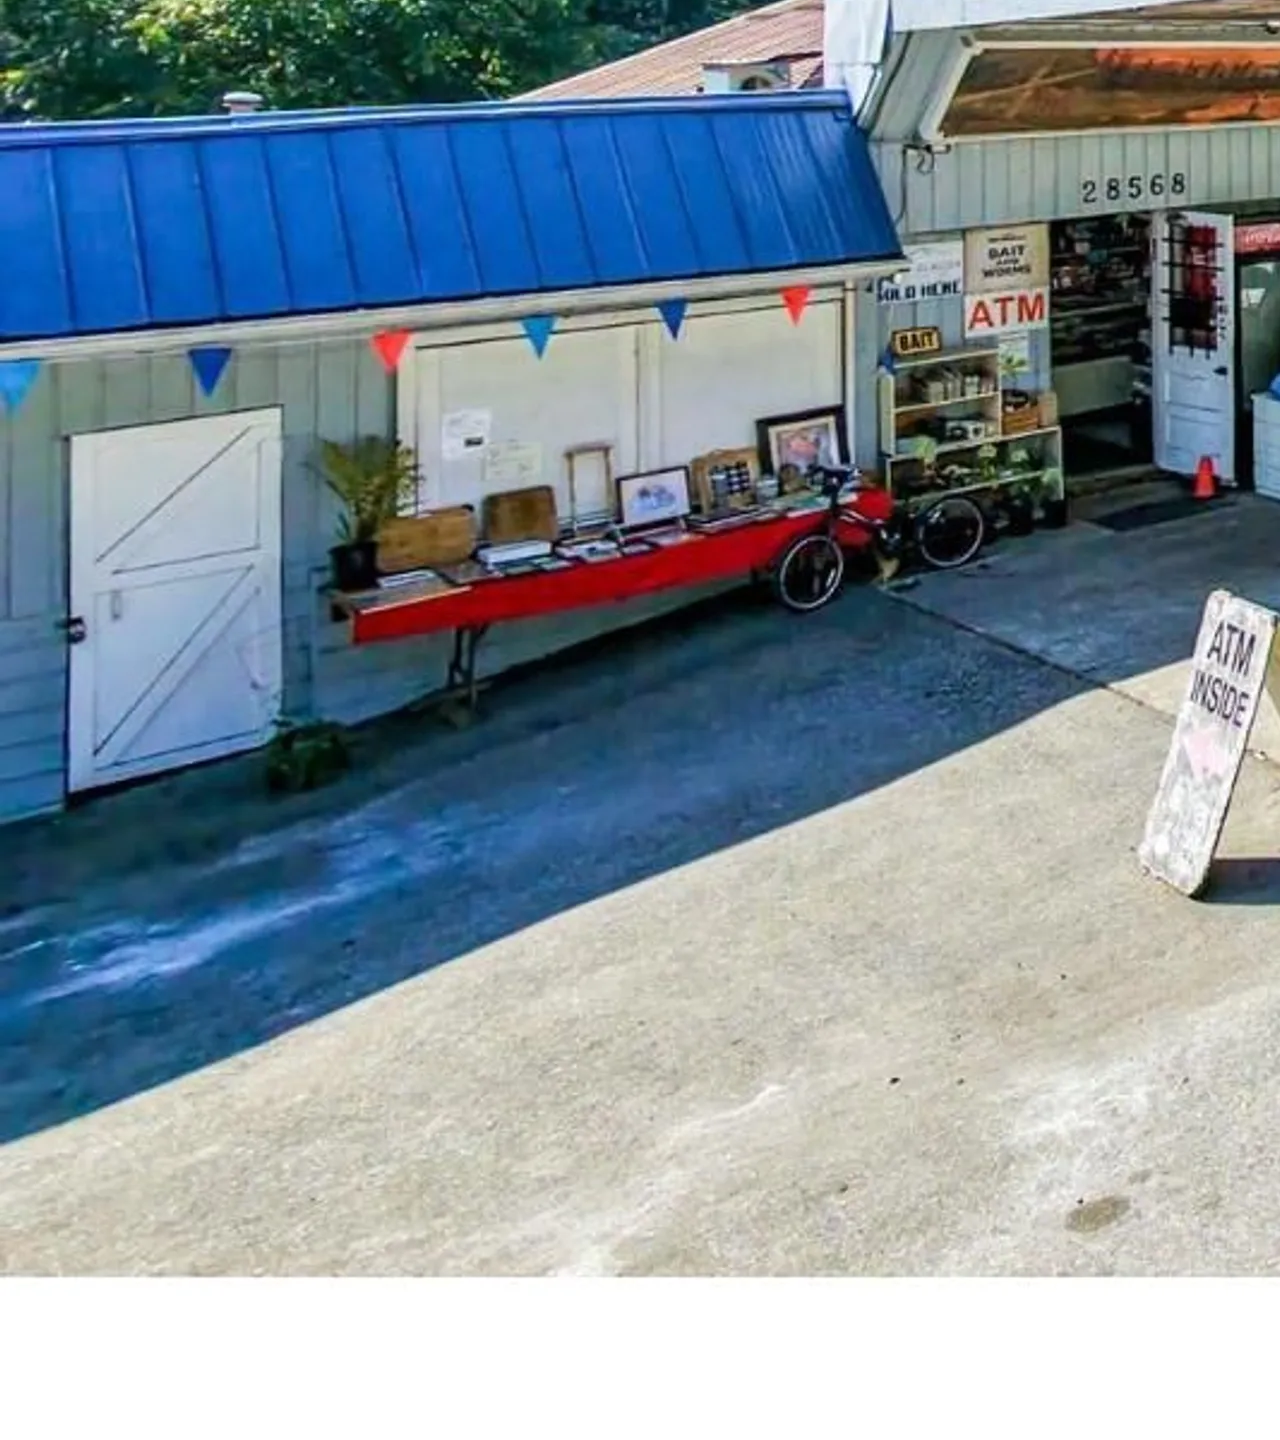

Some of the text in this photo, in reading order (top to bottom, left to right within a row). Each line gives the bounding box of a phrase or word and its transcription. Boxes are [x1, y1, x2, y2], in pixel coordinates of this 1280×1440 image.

[1082, 173, 1186, 203] 28568
[988, 245, 1025, 260] BAIT
[967, 291, 1044, 331] ATM
[899, 331, 934, 351] BAIT
[1206, 619, 1256, 677] ATM
[1189, 669, 1250, 728] INSIDE
